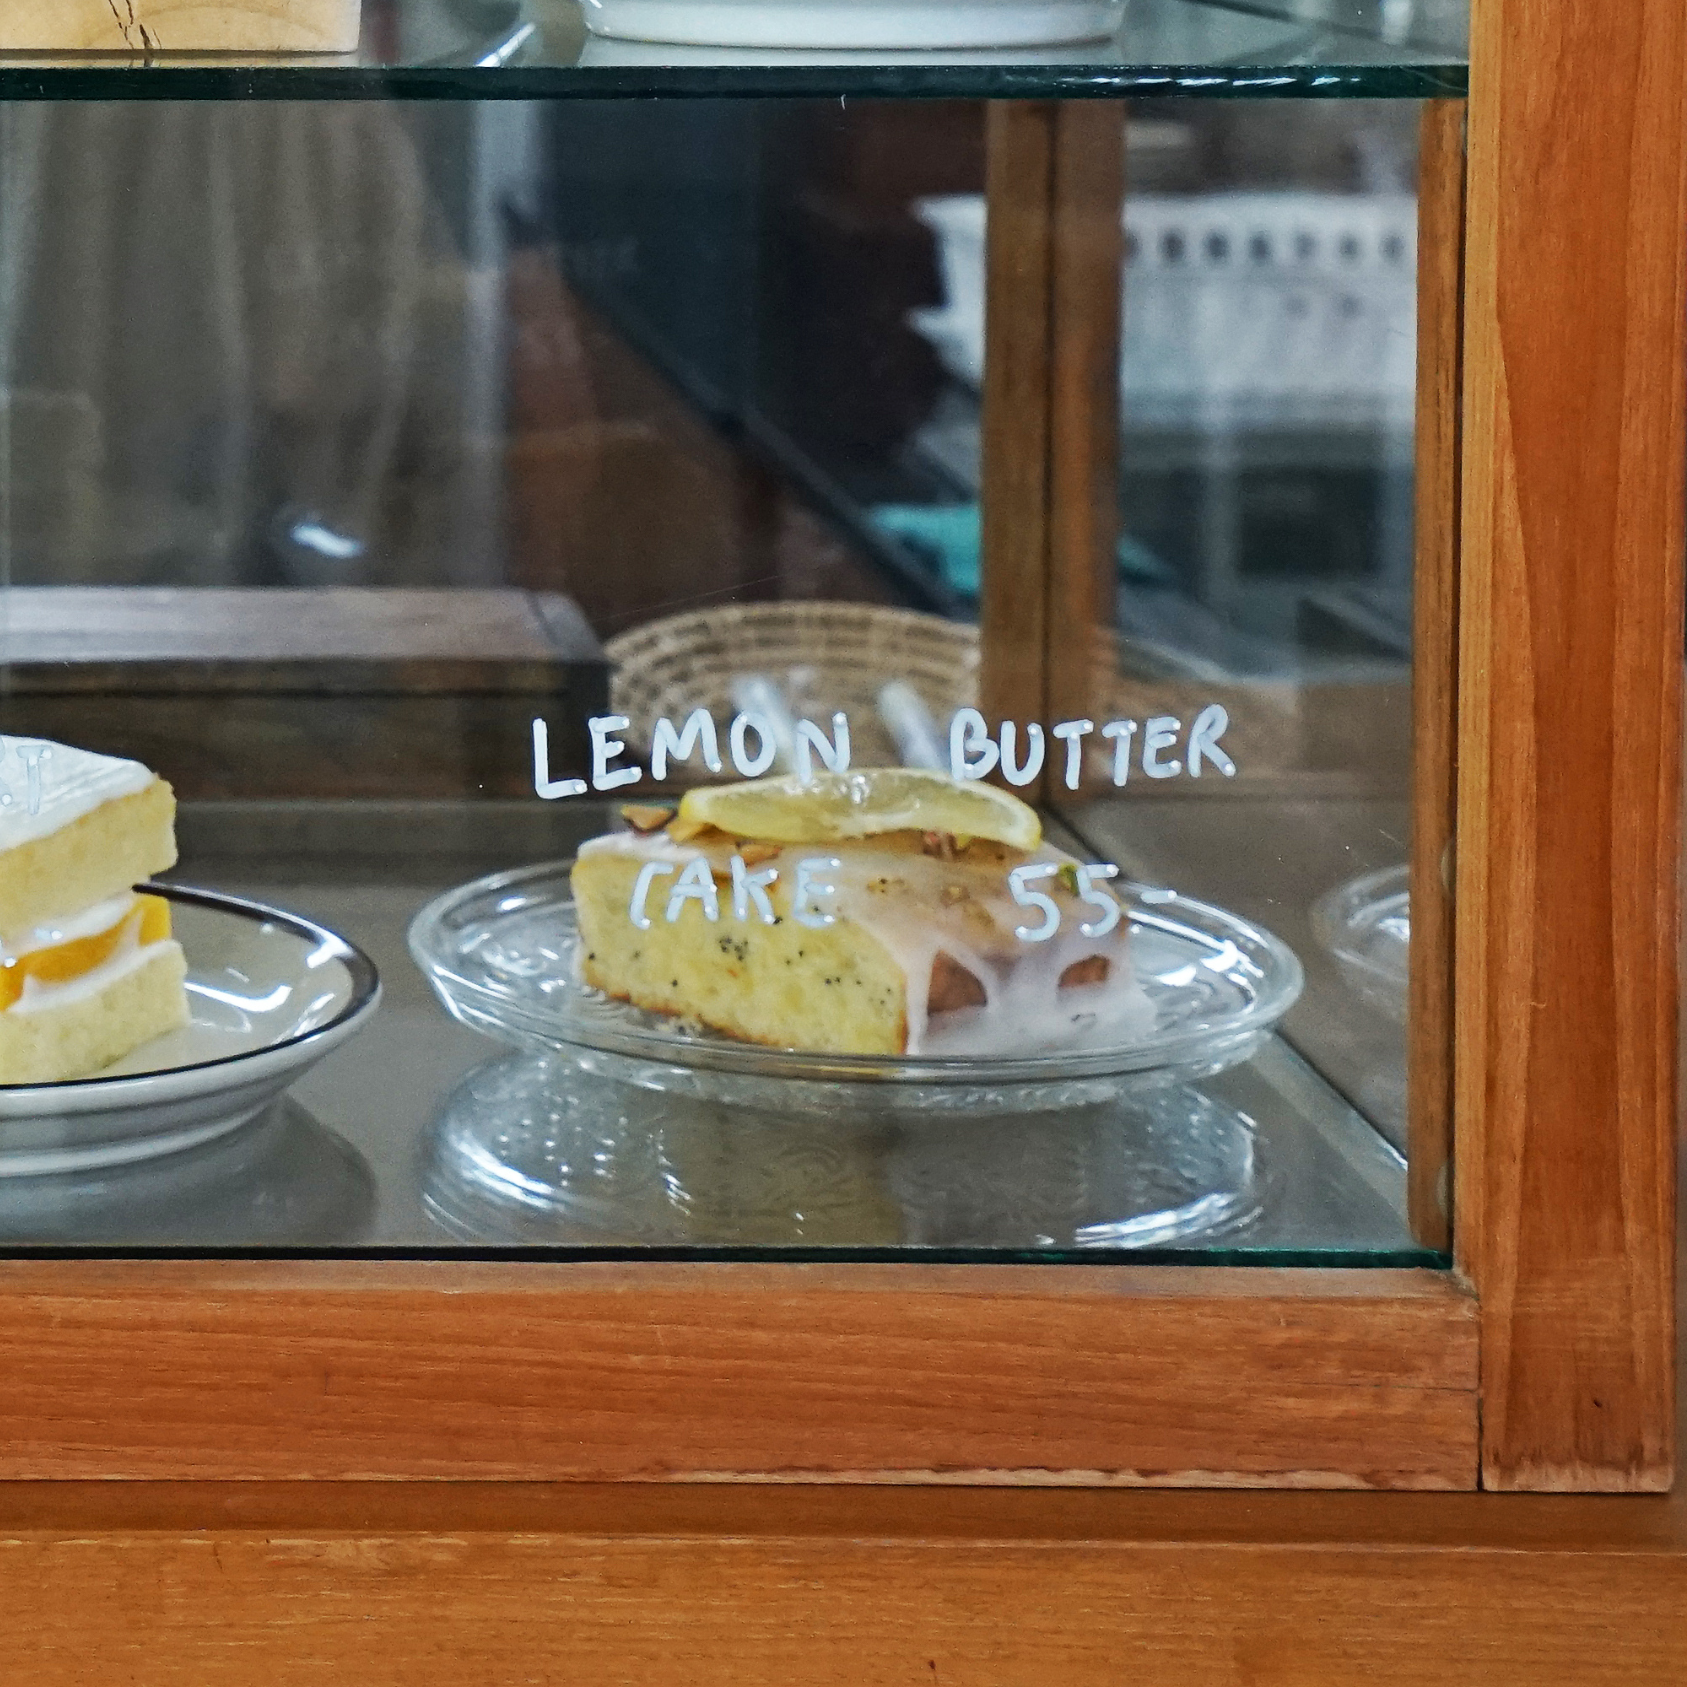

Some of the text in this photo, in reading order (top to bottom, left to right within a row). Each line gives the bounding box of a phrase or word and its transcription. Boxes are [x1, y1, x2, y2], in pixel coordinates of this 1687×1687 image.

[531, 703, 1238, 800] LEMON BUTTER
[628, 855, 842, 930] CAKE
